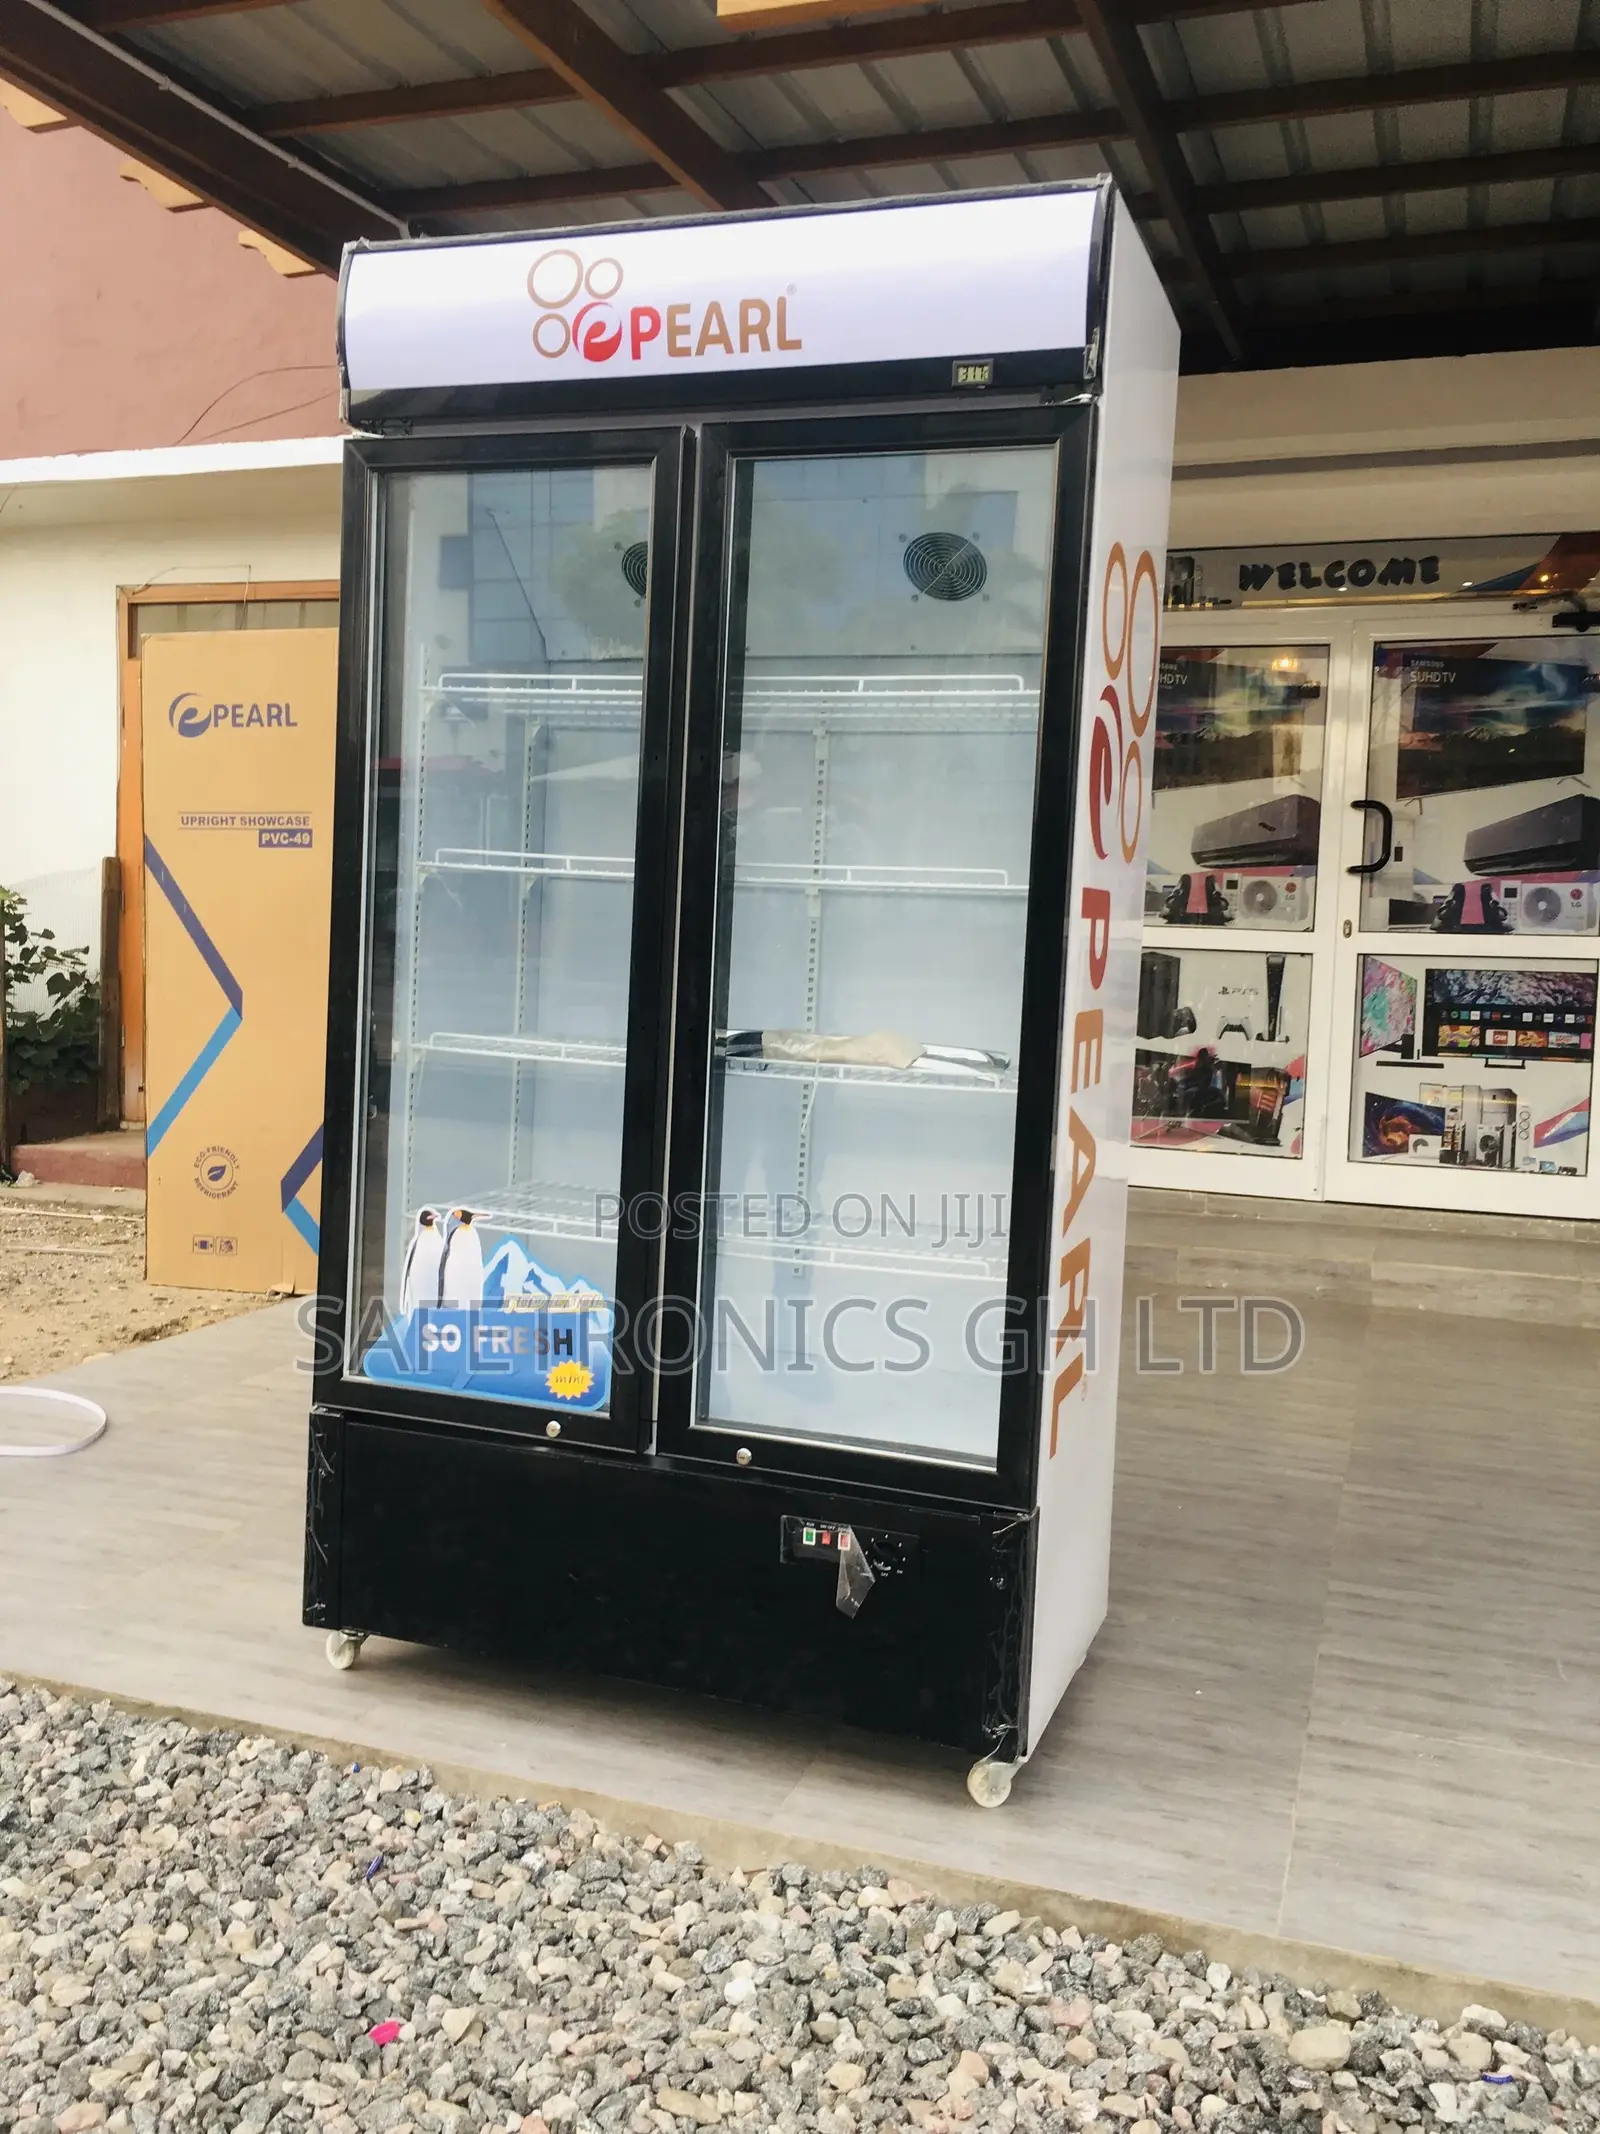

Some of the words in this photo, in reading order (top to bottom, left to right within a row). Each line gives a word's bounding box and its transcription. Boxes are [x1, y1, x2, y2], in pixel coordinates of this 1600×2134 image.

[630, 296, 802, 361] PEARL
[1239, 555, 1440, 592] WELCOME
[213, 703, 298, 728] PEARL
[181, 816, 236, 826] UPRIGHT
[240, 816, 310, 827] SHOWCASE
[261, 833, 311, 844] PVC-49
[1048, 887, 1112, 1459] PEARL
[421, 1323, 461, 1353] SO
[473, 1324, 574, 1356] FRESH
